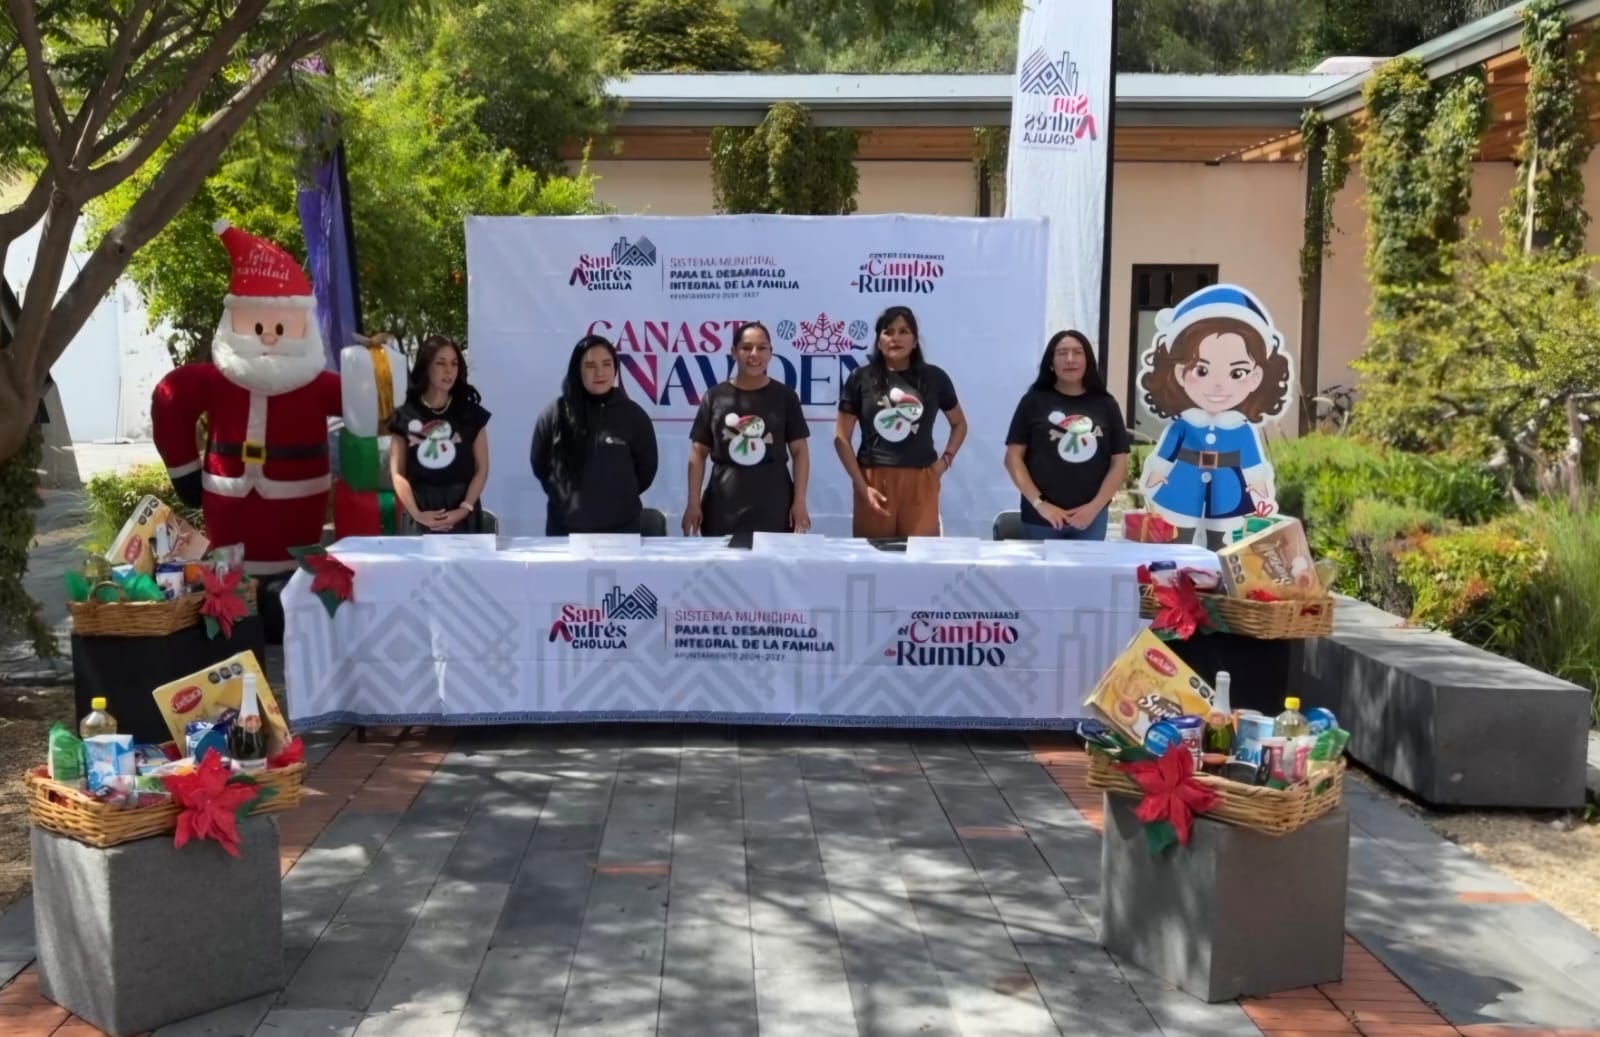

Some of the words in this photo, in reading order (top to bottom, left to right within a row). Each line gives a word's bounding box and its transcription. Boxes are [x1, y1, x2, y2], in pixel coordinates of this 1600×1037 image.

[670, 270, 698, 279] PARA
[700, 270, 713, 279] EL
[716, 268, 786, 278] DESARROLLO
[868, 259, 944, 278] Cambio
[670, 281, 721, 290] INTEGRAL
[724, 280, 739, 290] DE
[741, 279, 755, 289] LA
[757, 279, 800, 290] FAMILIA
[859, 274, 934, 294] Rumbo
[562, 604, 601, 622] San
[675, 610, 733, 622] SISTEMA
[735, 611, 807, 624] MUNICIPAL
[549, 619, 627, 642] Andrés
[674, 625, 709, 635] PARA
[712, 626, 728, 636] EL
[731, 626, 817, 638] DESARROLLO
[898, 625, 908, 635] el
[910, 620, 1018, 644] Cambio
[572, 639, 627, 649] CHOLULA
[674, 638, 738, 649] INTEGRAL
[742, 639, 759, 650] DE
[762, 640, 779, 650] LA
[782, 640, 835, 652] FAMILIA
[897, 640, 1006, 667] Rumbo
